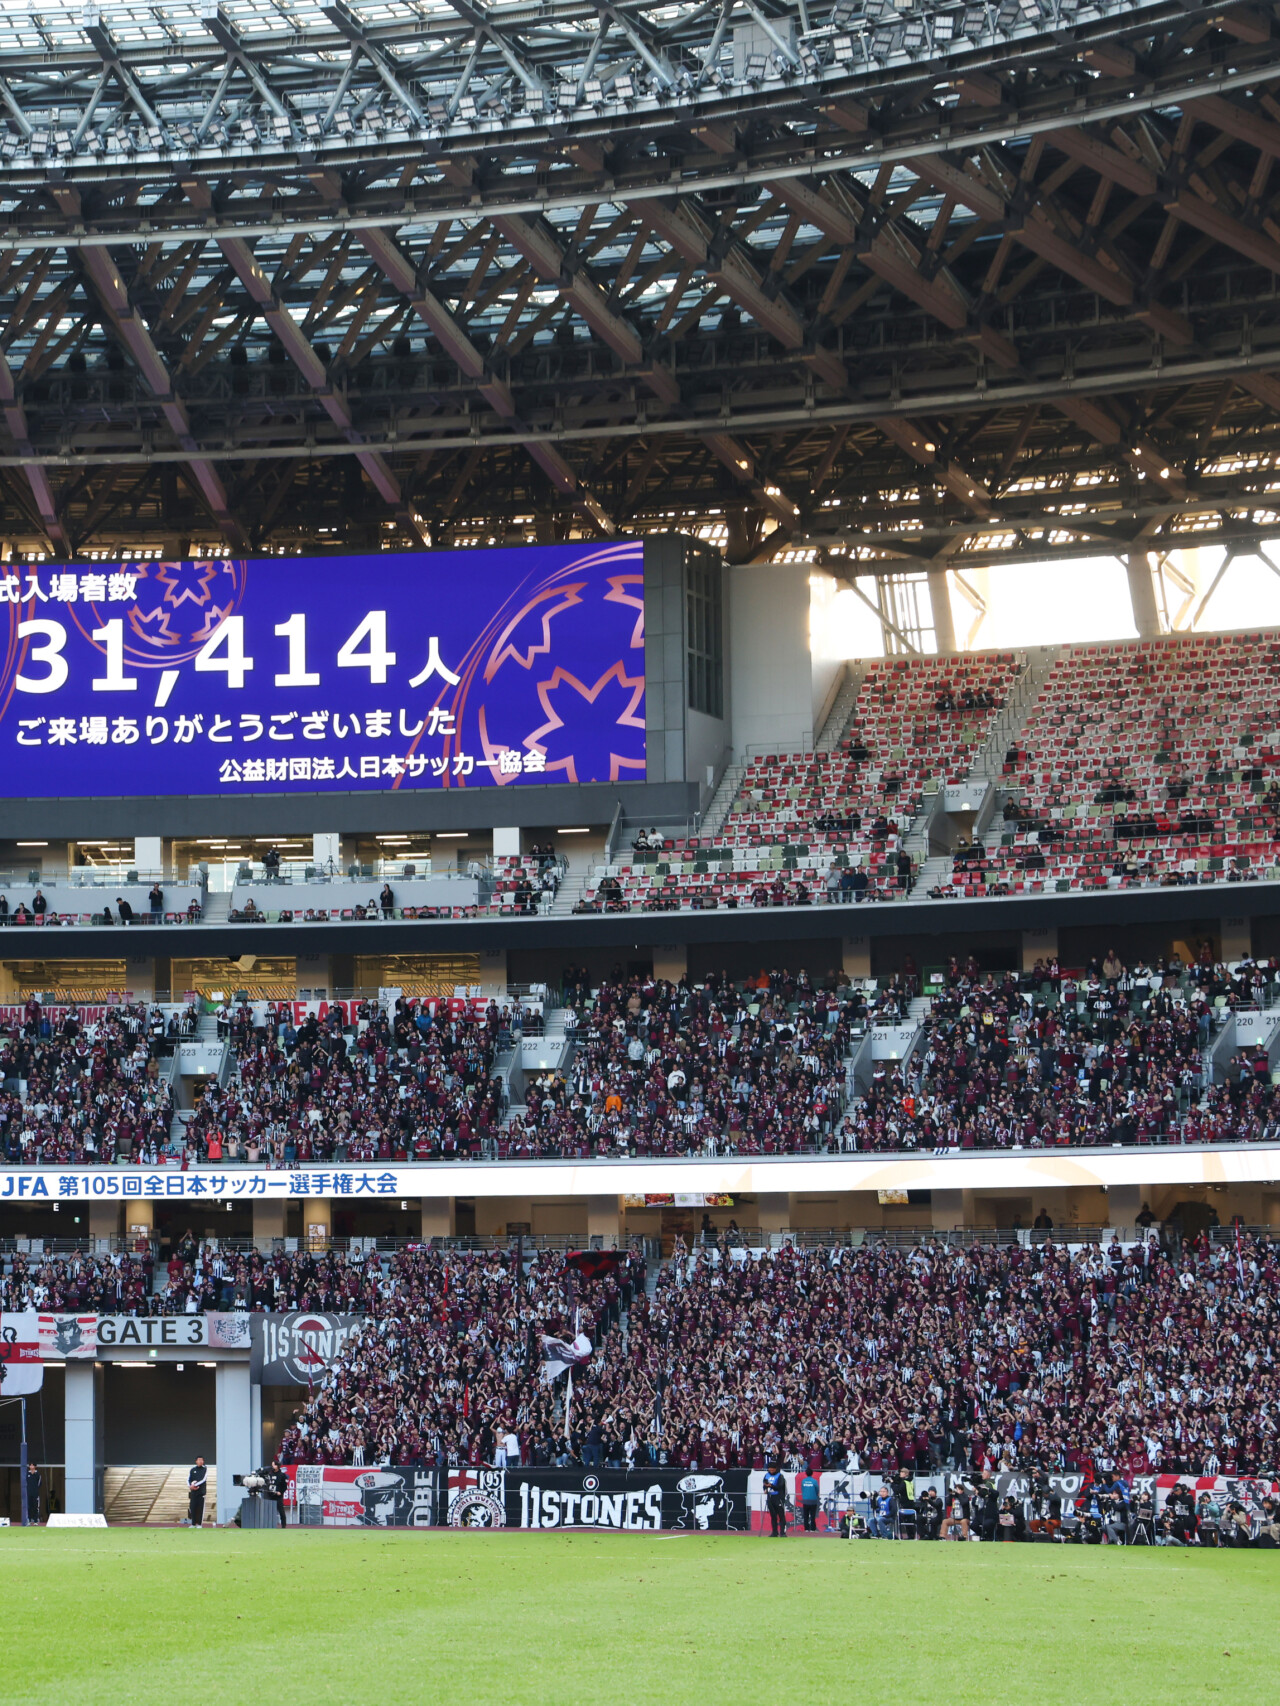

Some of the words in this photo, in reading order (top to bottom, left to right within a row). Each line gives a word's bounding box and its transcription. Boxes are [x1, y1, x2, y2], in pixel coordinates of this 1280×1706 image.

[17, 706, 457, 746] ご来場ありがとうございました
[219, 750, 548, 783] 公益財団法人日本サッカー協会
[1237, 1018, 1254, 1026] 220
[873, 1033, 887, 1041] 221
[2, 1177, 49, 1197] JFA
[59, 1173, 398, 1196] 第105回全日本サッカー選手権大会
[97, 1319, 177, 1344] GATE
[188, 1319, 203, 1344] 3
[486, 1472, 499, 1487] 95
